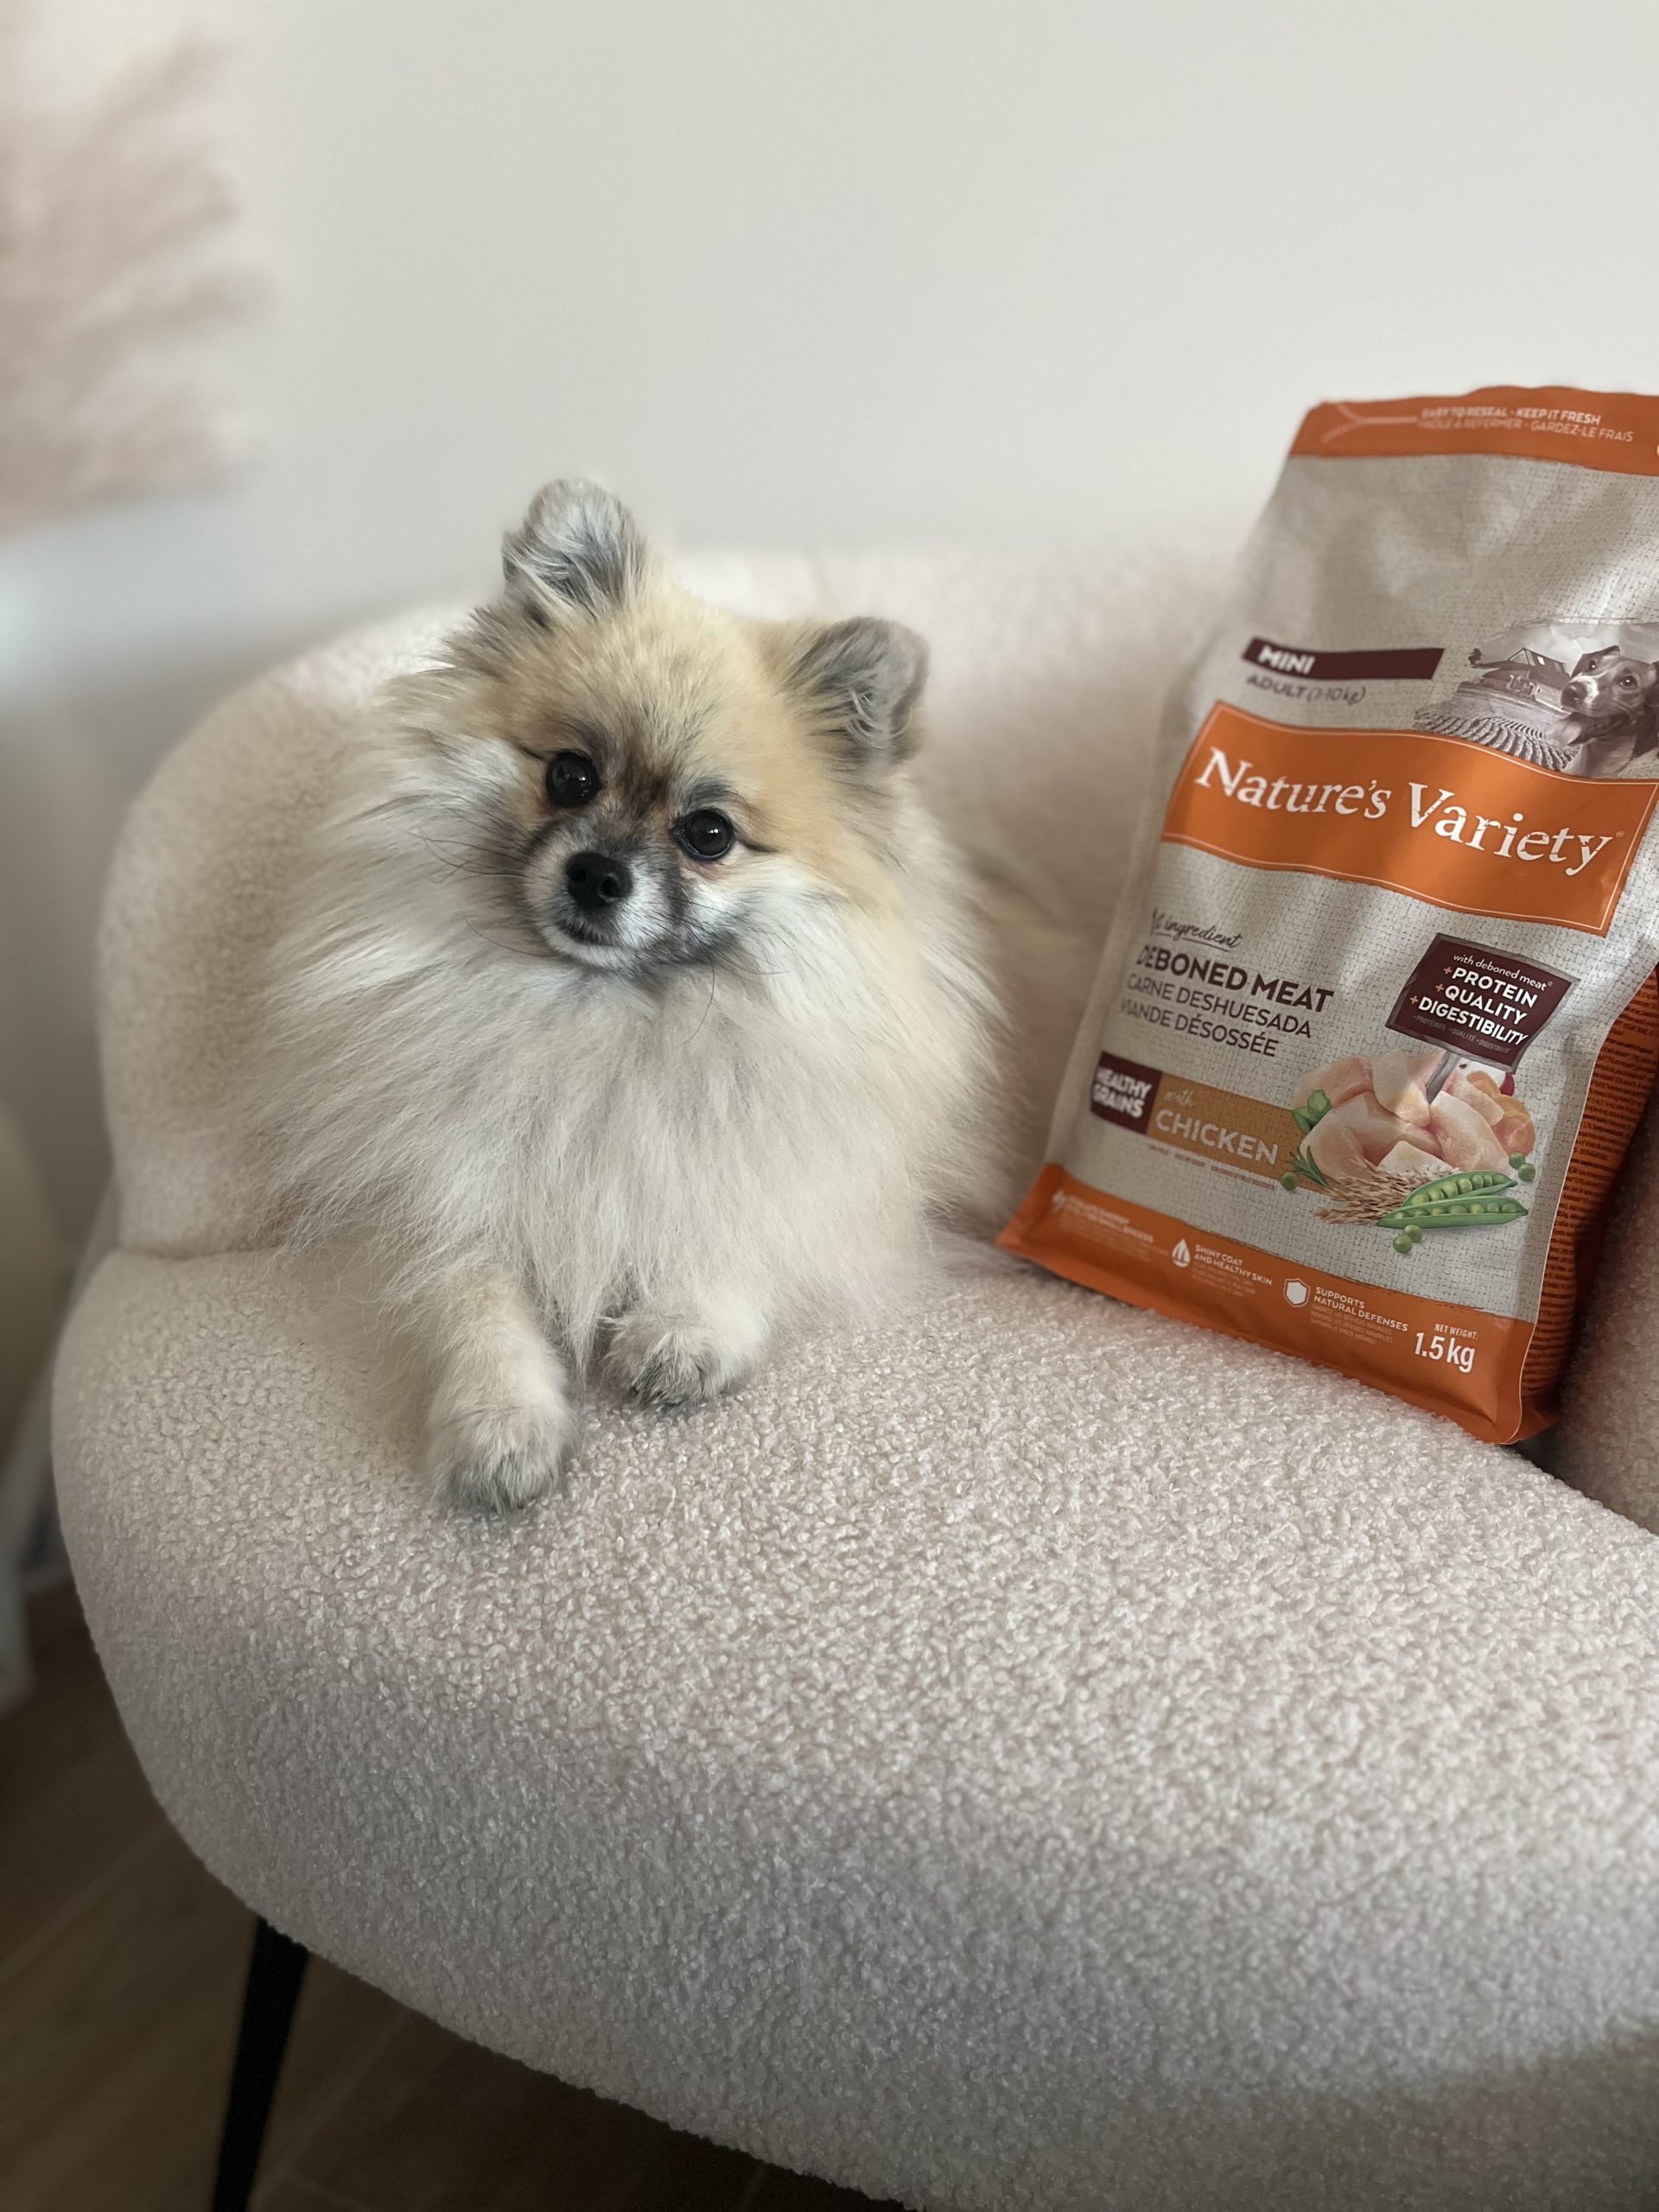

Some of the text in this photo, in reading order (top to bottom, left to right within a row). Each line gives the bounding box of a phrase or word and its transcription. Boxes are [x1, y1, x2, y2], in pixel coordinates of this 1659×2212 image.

[1516, 407, 1548, 419] KEEP
[1548, 410, 1560, 420] IT
[1560, 410, 1601, 425] FRESH
[1531, 420, 1597, 438] GARDEZ-LE
[1599, 429, 1634, 442] FRAIS
[1257, 644, 1316, 675] MINI
[1246, 674, 1307, 698] ADULT
[1194, 747, 1393, 819] Nature's
[1163, 916, 1243, 949] ingredient
[1136, 944, 1335, 1013] DEBONED MEAT
[1453, 954, 1474, 966] with
[1475, 958, 1521, 980] deboned
[1126, 973, 1312, 1039] CARNE DESHUESADA
[1174, 1014, 1280, 1058] DÉSOSSÉE
[1155, 1108, 1279, 1166] CHICKEN
[1194, 1253, 1212, 1265] AND
[1213, 1259, 1252, 1279] HEALTHY
[1251, 1273, 1273, 1286] SKIN
[1195, 1244, 1244, 1267] SHINY COAT
[1313, 1295, 1357, 1318] NATURAL
[1357, 1308, 1409, 1332] DEFENSES
[1315, 1287, 1365, 1309] SUPPORTS
[1434, 1323, 1449, 1333] NET
